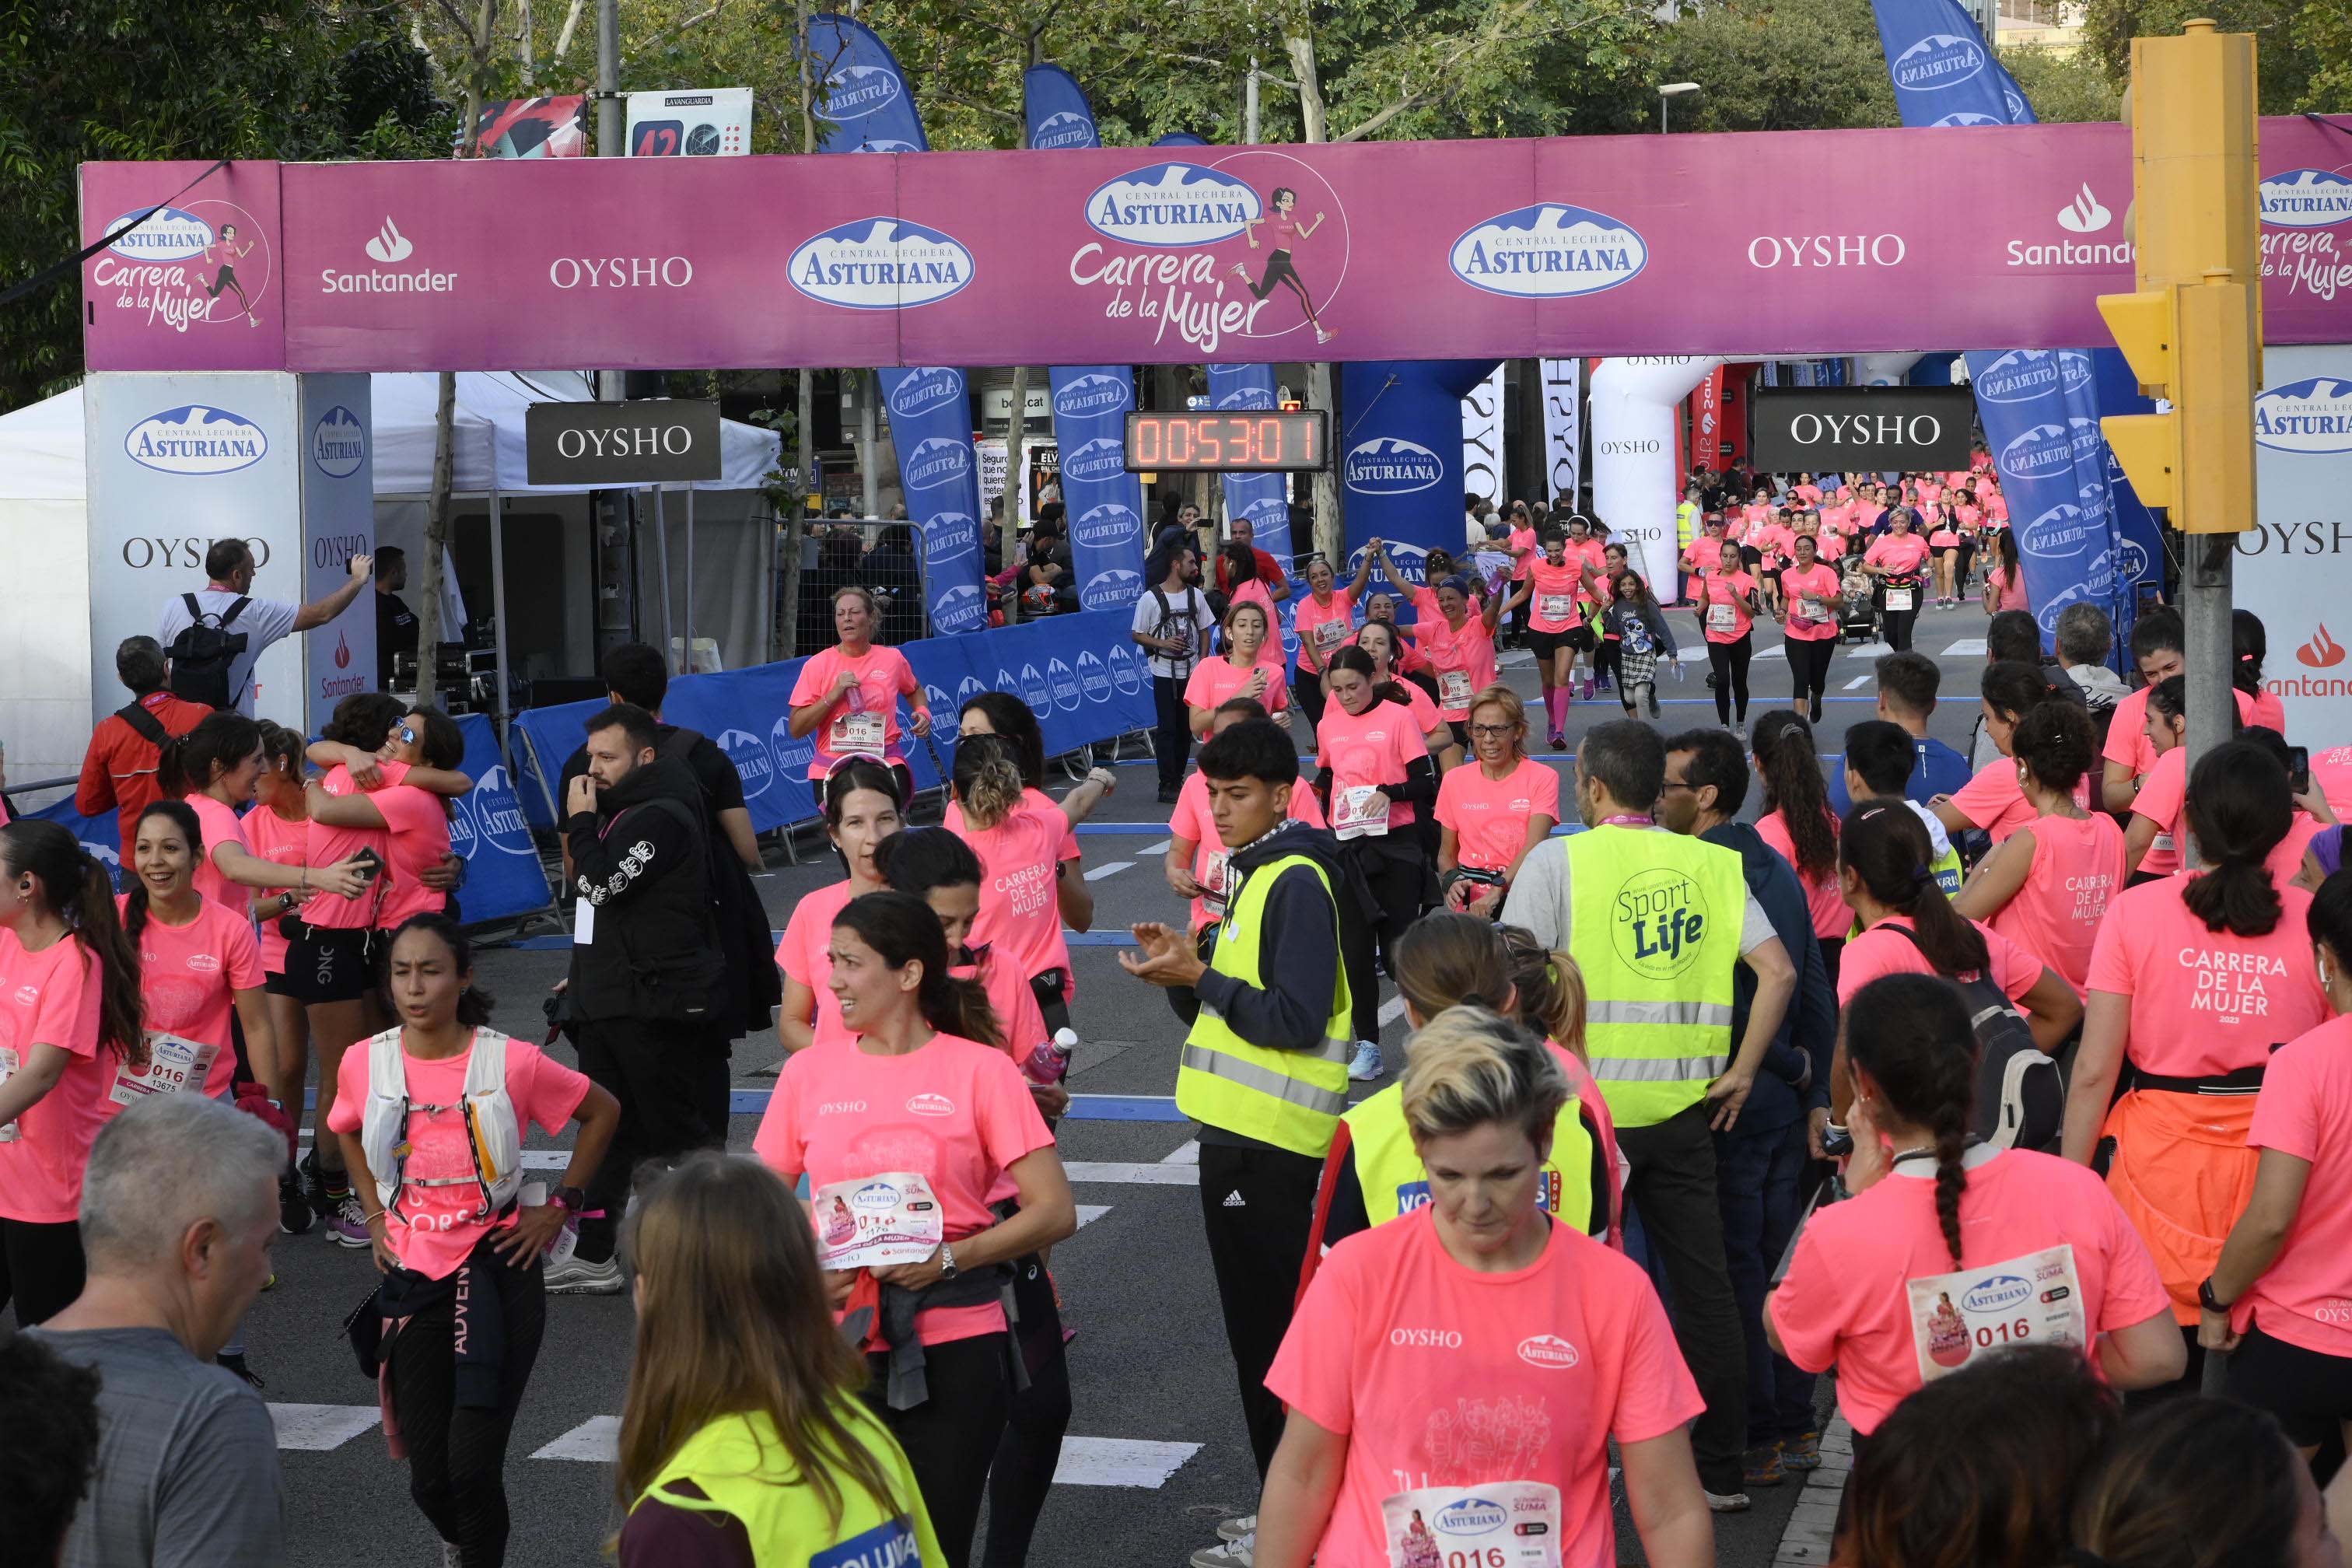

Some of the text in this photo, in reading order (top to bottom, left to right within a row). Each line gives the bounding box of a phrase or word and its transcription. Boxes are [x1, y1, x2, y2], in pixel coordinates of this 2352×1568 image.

[674, 97, 712, 106] VANGUARDIA
[1125, 191, 1244, 201] CENTRAL LECHERA
[1098, 194, 1246, 226] ASTURIANA
[831, 248, 954, 258] CENTRAL LECHERA
[1495, 234, 1626, 247] CENTRAL LECHERA
[1748, 233, 1906, 268] OYSHO
[802, 252, 960, 286] ASTURIANA
[1069, 243, 1216, 286] Carrera
[1465, 240, 1633, 275] ASTURIANA
[93, 257, 185, 287] Carrera
[321, 268, 457, 293] Santander
[549, 256, 693, 289] OYSHO
[117, 285, 221, 333] de la Mujer
[1105, 279, 1270, 353] de la Mujer
[2277, 404, 2332, 412] CENTRAL
[557, 425, 692, 458] OYSHO
[1137, 418, 1314, 463] 00:53:01
[1790, 414, 1941, 446] OYSHO
[136, 431, 258, 457] ASTURIANA
[317, 436, 362, 461] ASTURIANA
[1601, 439, 1661, 455] OYSHO
[1348, 460, 1436, 482] ASTURIANA
[122, 537, 271, 569] OYSO
[321, 672, 366, 699] Santander
[995, 862, 1048, 893] CARRERA
[2065, 873, 2114, 892] CARRERA
[1010, 880, 1045, 903] DE LA
[1618, 879, 1691, 922] Sport
[2076, 889, 2105, 905] DE LA
[1012, 891, 1048, 918] MUJER
[1632, 908, 1703, 960] Life
[2178, 947, 2287, 977] CARRERA
[2197, 970, 2266, 995] DE LA
[2190, 989, 2269, 1017] MUJER
[2218, 1015, 2240, 1024] 2023
[157, 1045, 193, 1063] ASTURIANA
[152, 1064, 185, 1083] 016
[151, 1079, 177, 1094] 13675
[819, 1100, 867, 1116] OYSHO
[908, 1099, 952, 1114] ASTURIANA
[2036, 1267, 2065, 1282] SUMA
[1968, 1286, 2028, 1308] ASTURIANA
[1390, 1328, 1462, 1349] OYSHO
[1976, 1318, 2030, 1347] 016
[1522, 1343, 1575, 1363] ASTURIANA
[1514, 1503, 1547, 1512] SUMA
[1440, 1514, 1502, 1529] ASTURIANA
[1447, 1547, 1506, 1568] 016
